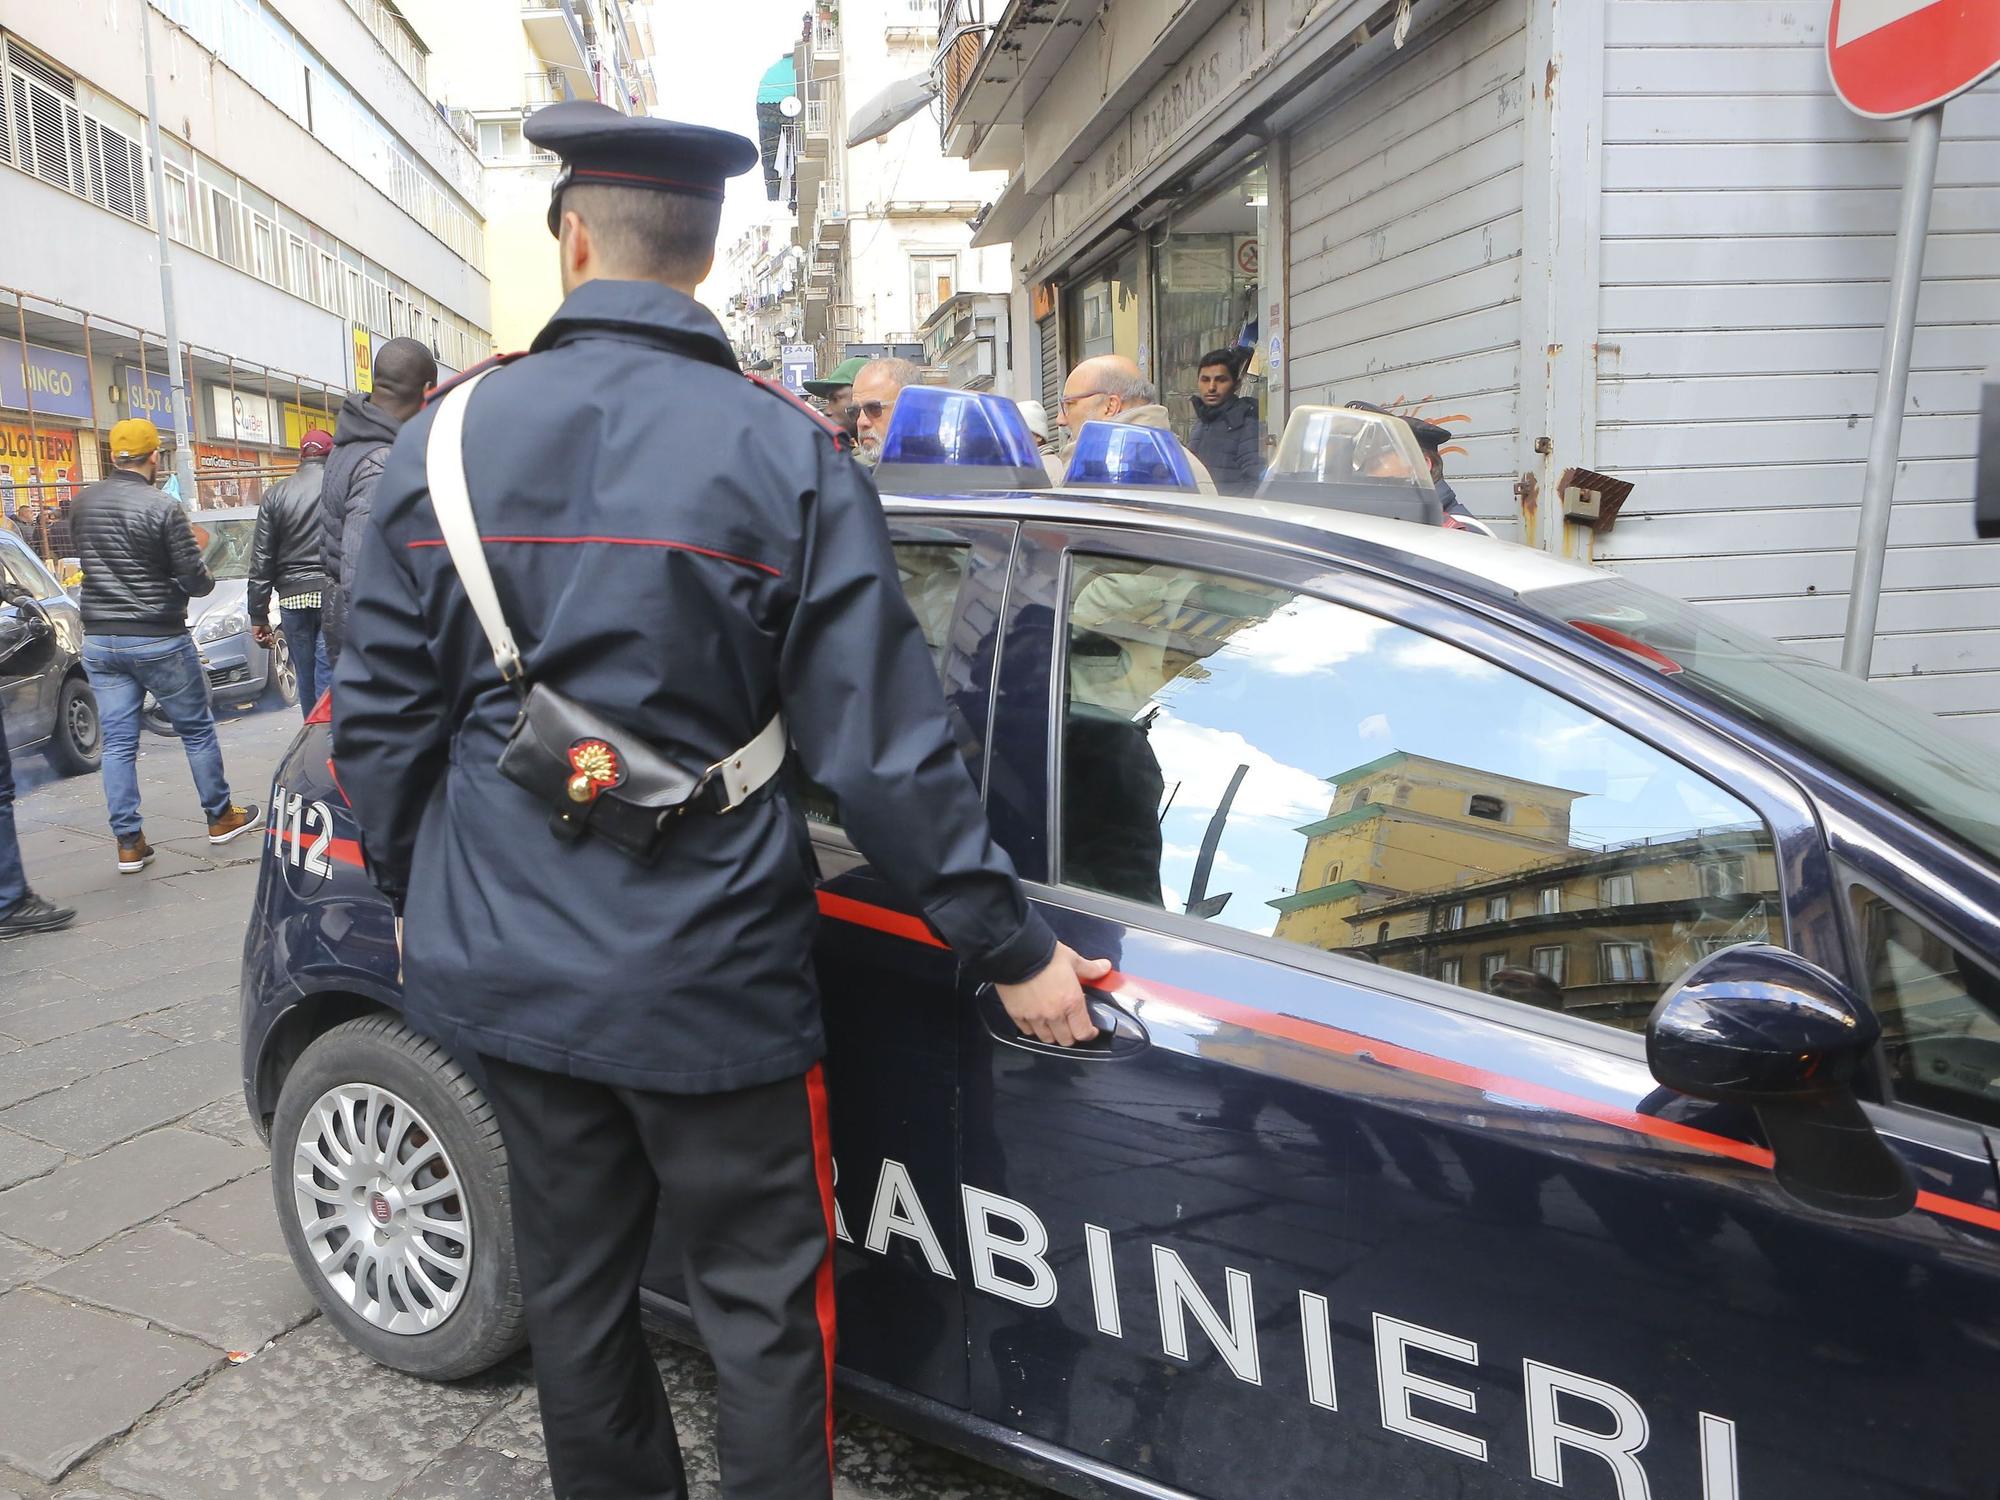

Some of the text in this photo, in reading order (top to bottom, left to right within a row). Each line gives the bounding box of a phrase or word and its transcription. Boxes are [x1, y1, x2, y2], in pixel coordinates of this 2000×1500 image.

[355, 342, 369, 369] MD
[783, 346, 812, 354] BAR
[790, 364, 807, 387] T
[131, 384, 161, 411] SLOT
[164, 396, 172, 413] &
[273, 784, 333, 880] 112
[375, 1200, 388, 1217] FIAT
